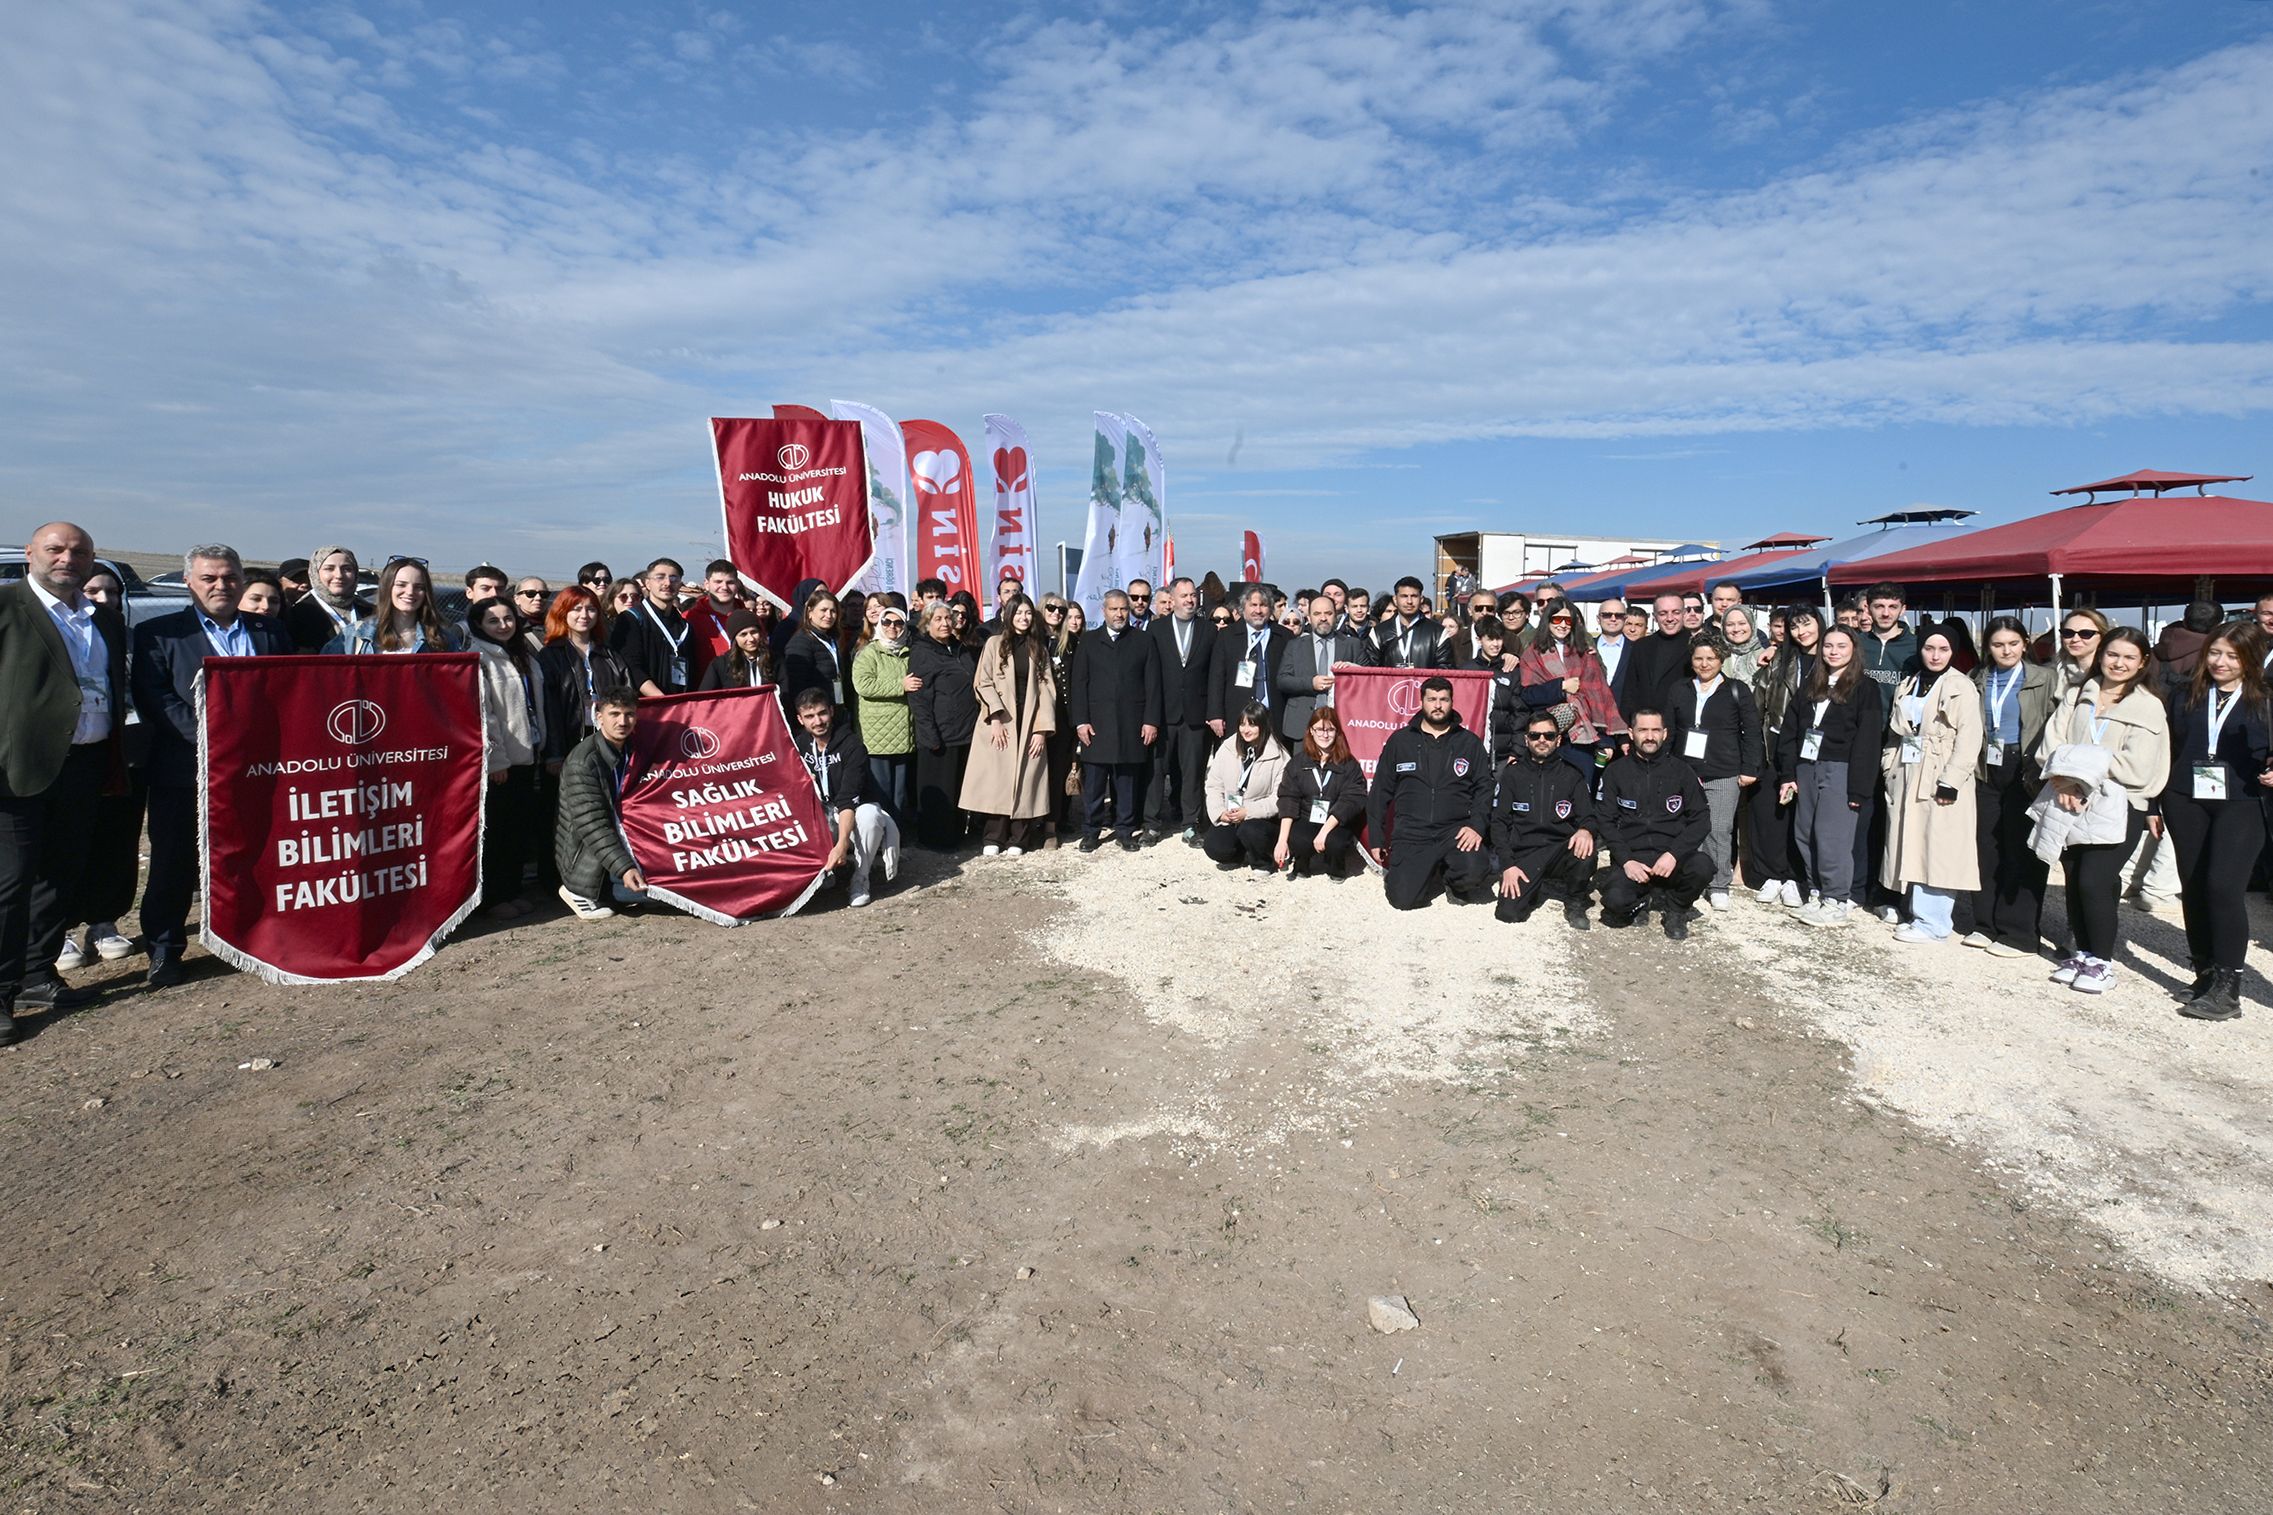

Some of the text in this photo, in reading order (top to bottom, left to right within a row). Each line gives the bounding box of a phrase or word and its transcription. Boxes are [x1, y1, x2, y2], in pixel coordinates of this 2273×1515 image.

[738, 466, 847, 484] ANADOLU ÜNİVERSİTESİ
[768, 486, 825, 510] HUKUK
[757, 504, 841, 534] FAKÜLTESİ
[1347, 719, 1398, 731] ANADOLU
[246, 745, 449, 778] ANADOLU ÜNİVERSİTESİ
[639, 751, 777, 784] ANADOLU ÜNİVERSİTESİ
[288, 776, 413, 822] İLETİŞİM
[671, 778, 764, 809] SAĞLIK
[663, 794, 793, 845] BİLİMLERİ
[277, 813, 423, 867] BİLİMLERİ
[672, 819, 809, 873] FAKÜLTESİ
[276, 853, 428, 913] FAKÜLTESİ
